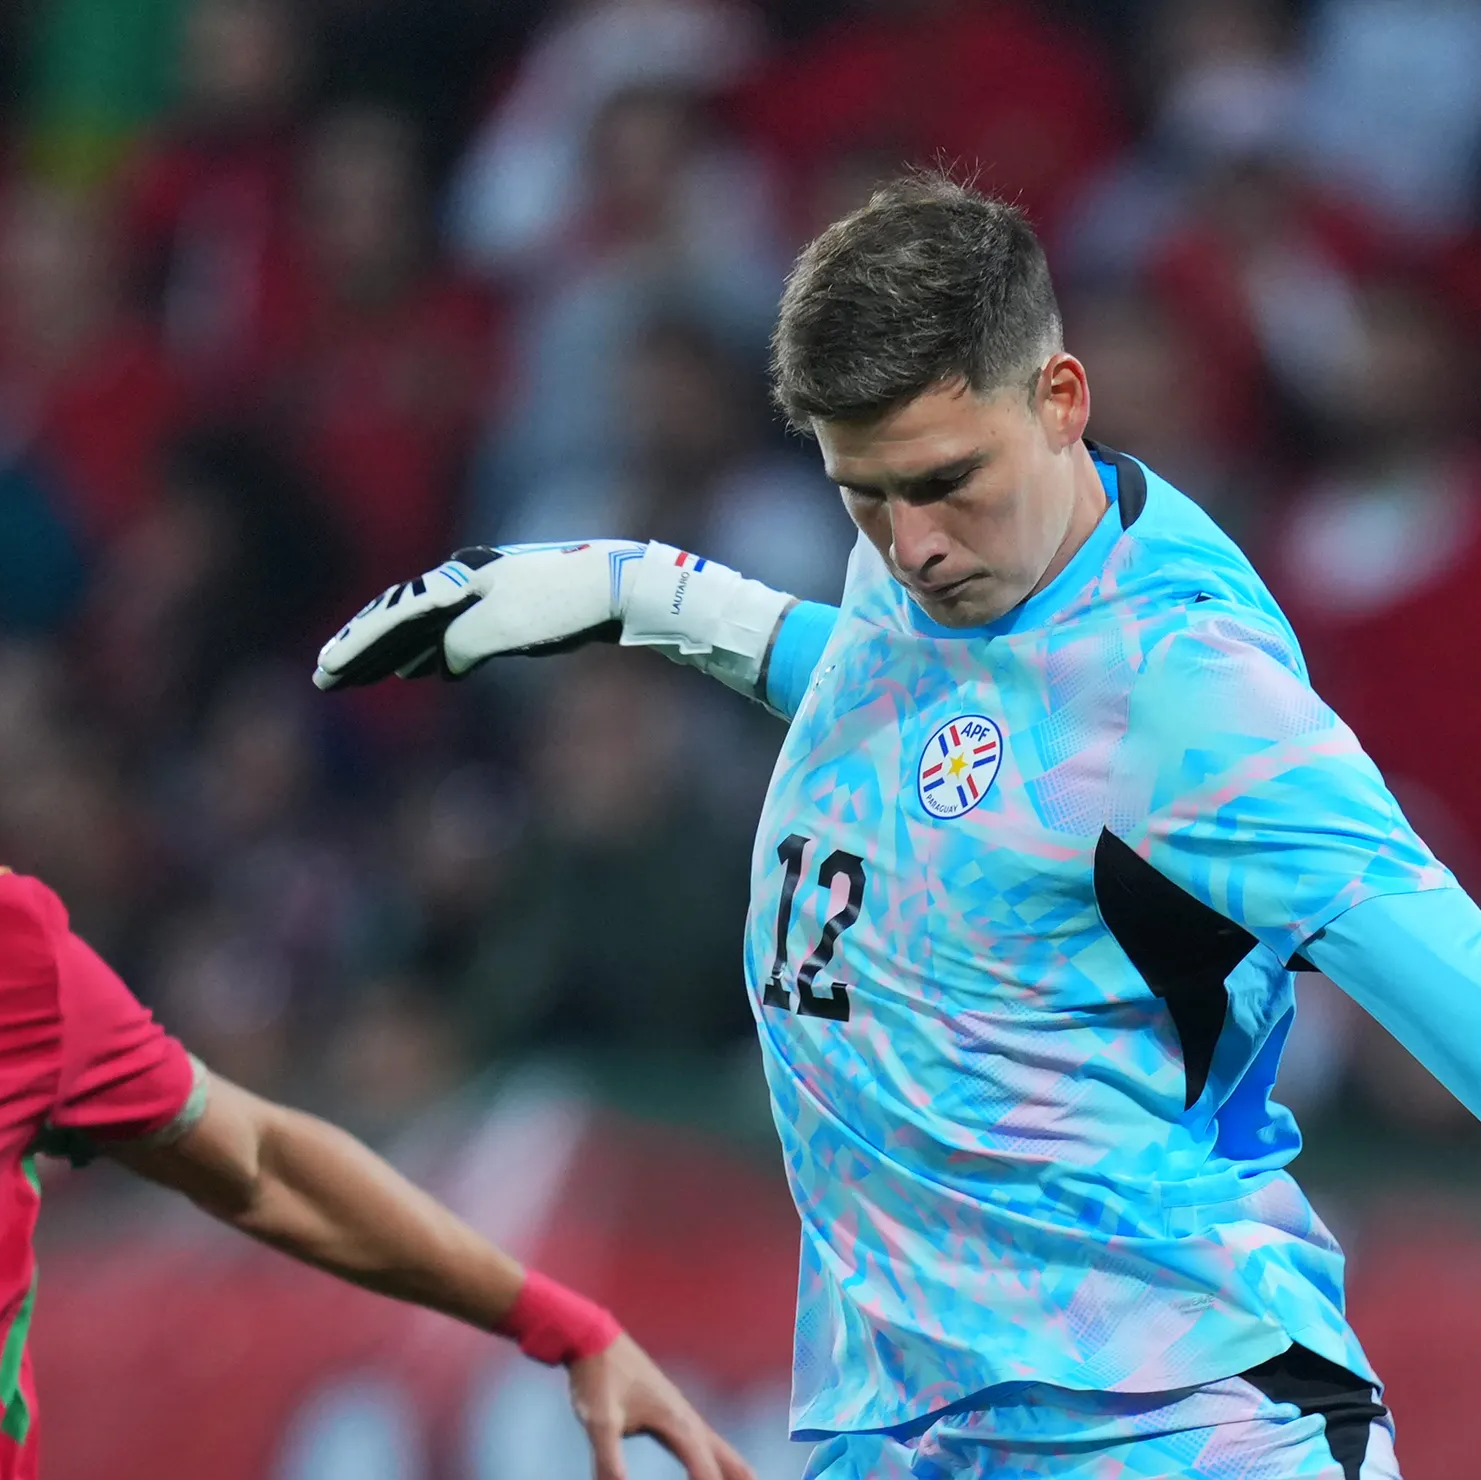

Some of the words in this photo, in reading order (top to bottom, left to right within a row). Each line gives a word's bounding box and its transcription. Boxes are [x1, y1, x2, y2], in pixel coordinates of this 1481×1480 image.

[670, 571, 690, 616] LAUTARO
[960, 721, 991, 742] APF
[925, 793, 959, 814] PARAGUAY
[762, 832, 867, 1022] 12
